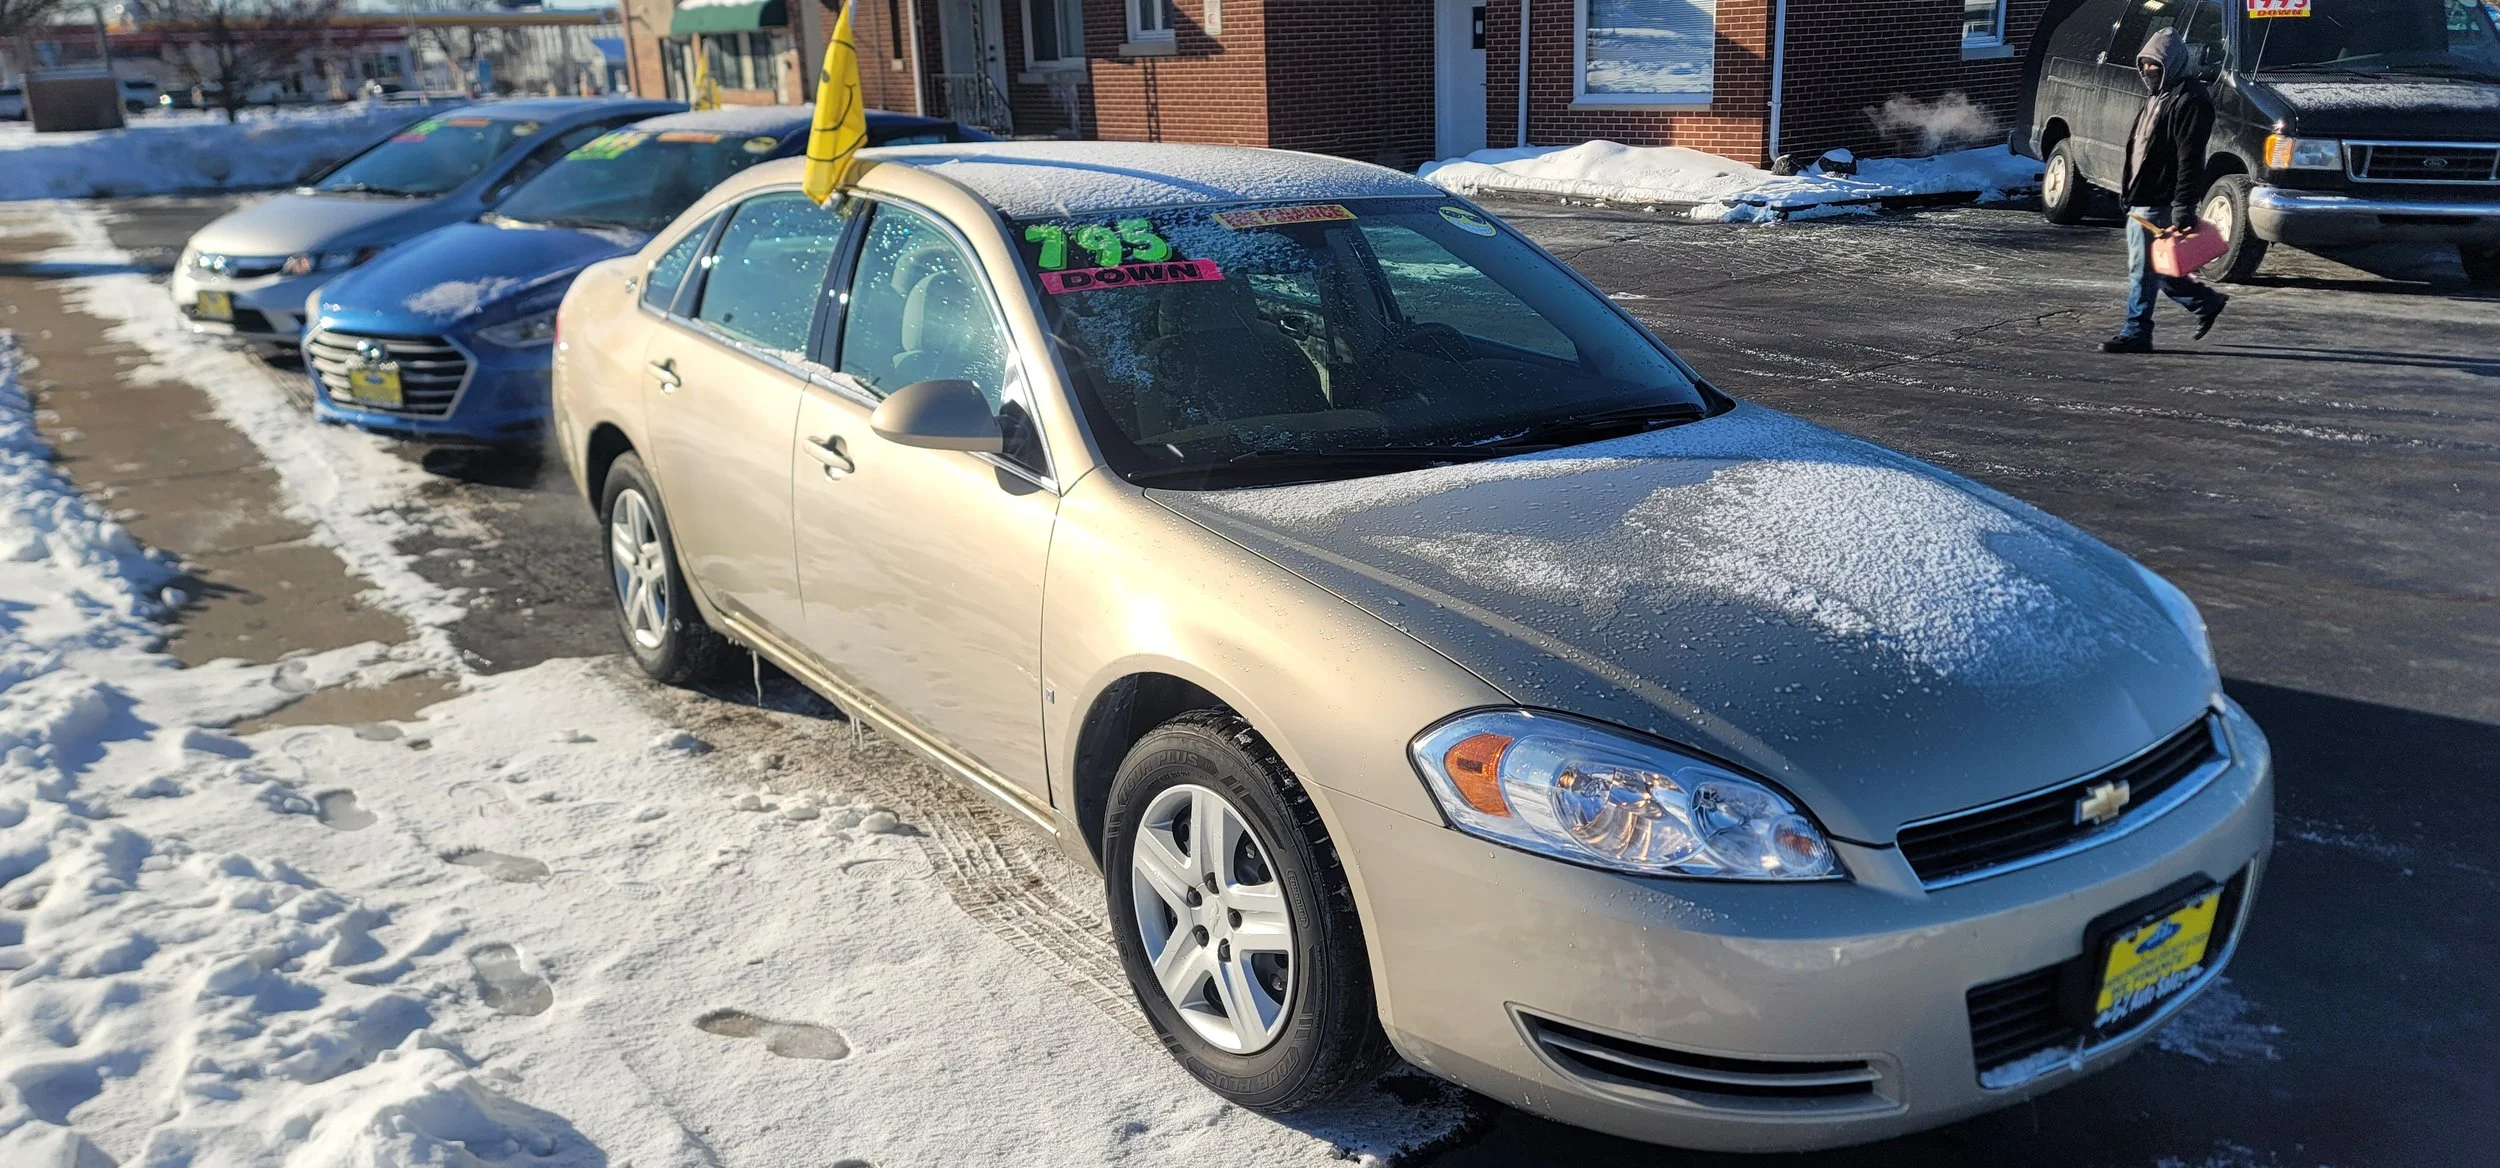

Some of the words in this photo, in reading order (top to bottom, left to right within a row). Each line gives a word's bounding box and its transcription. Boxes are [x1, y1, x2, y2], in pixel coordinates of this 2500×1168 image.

[1025, 217, 1172, 270] 795
[1060, 263, 1203, 289] DOWN
[1159, 749, 1199, 767] PLUS
[1203, 1070, 1252, 1093] PLUS
